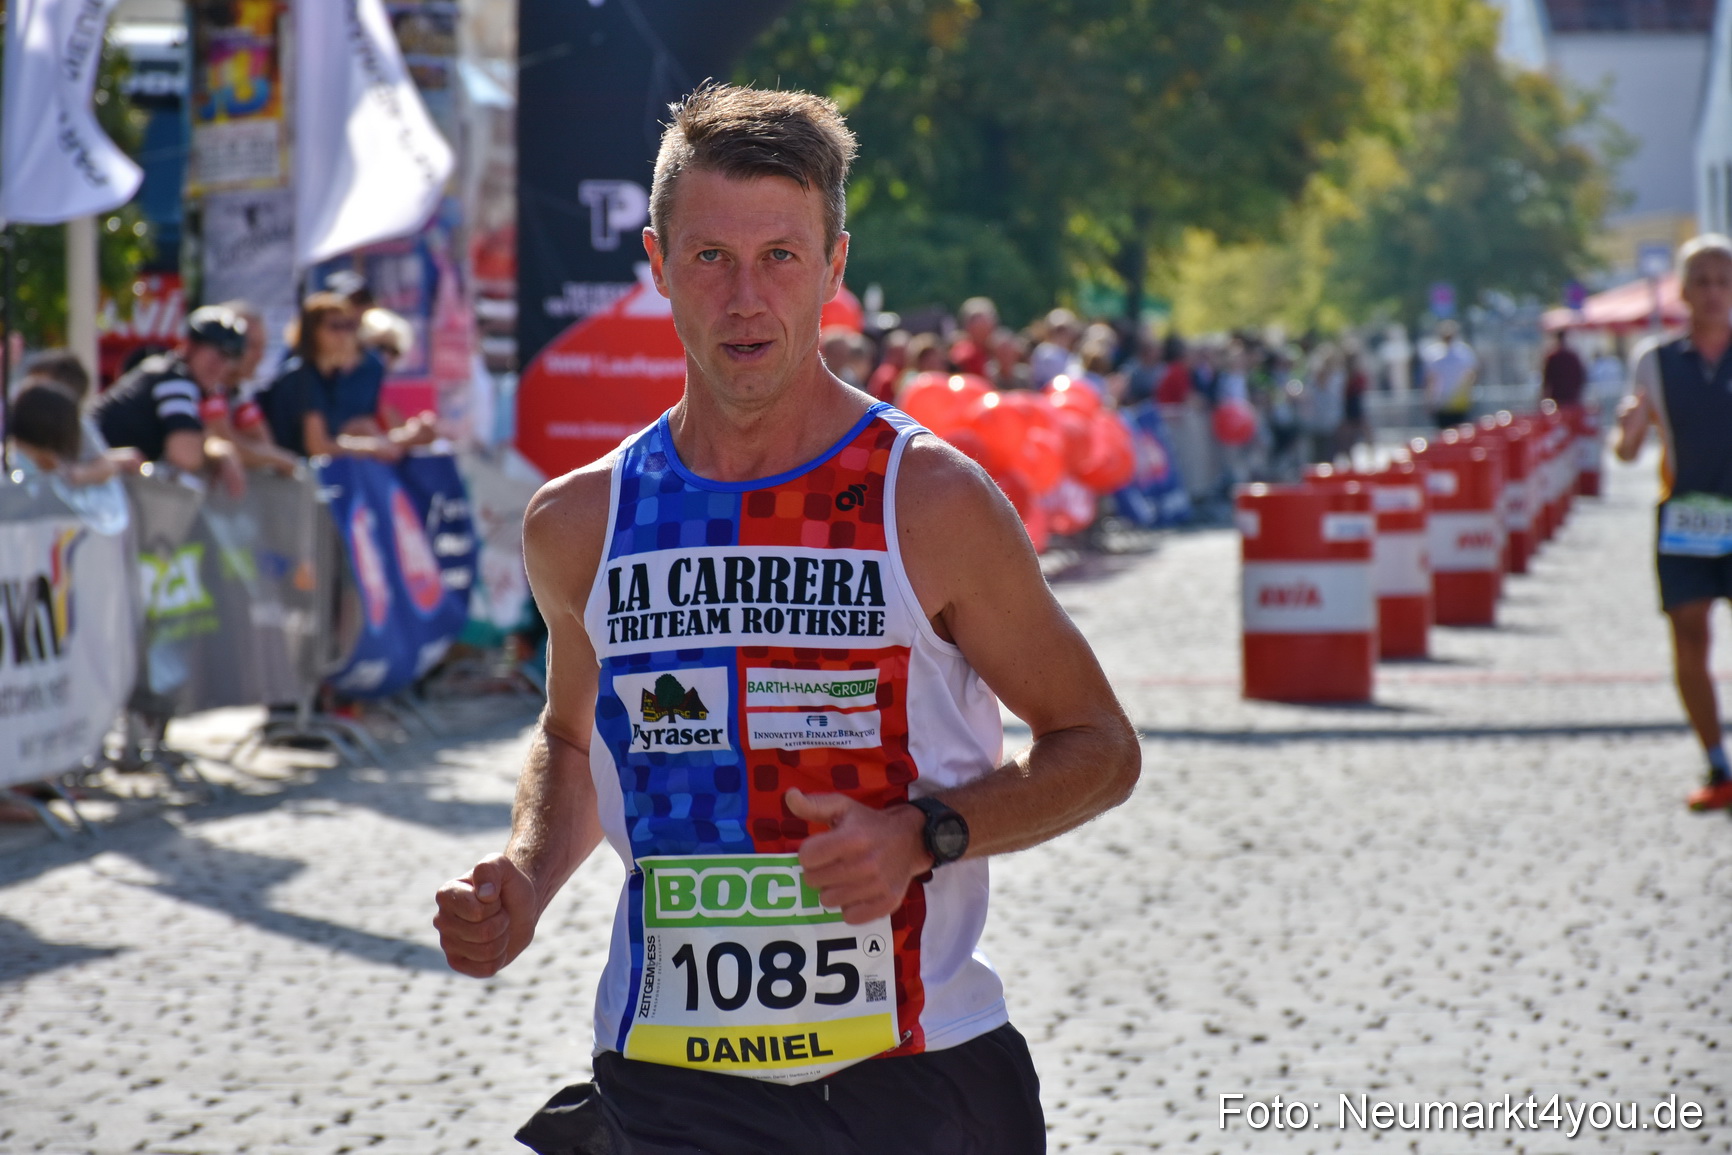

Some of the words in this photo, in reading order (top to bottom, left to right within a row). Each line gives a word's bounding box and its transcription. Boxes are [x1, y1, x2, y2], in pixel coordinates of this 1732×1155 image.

[607, 563, 651, 615] LA
[667, 556, 886, 607] CARRERA
[607, 607, 731, 644] TRITEAM
[741, 607, 886, 637] ROTHSEE
[631, 724, 724, 749] Pyraser
[754, 731, 804, 740] INNOVATIVE
[868, 939, 881, 953] A
[671, 937, 860, 1012] 1085
[686, 1032, 833, 1063] DANIEL
